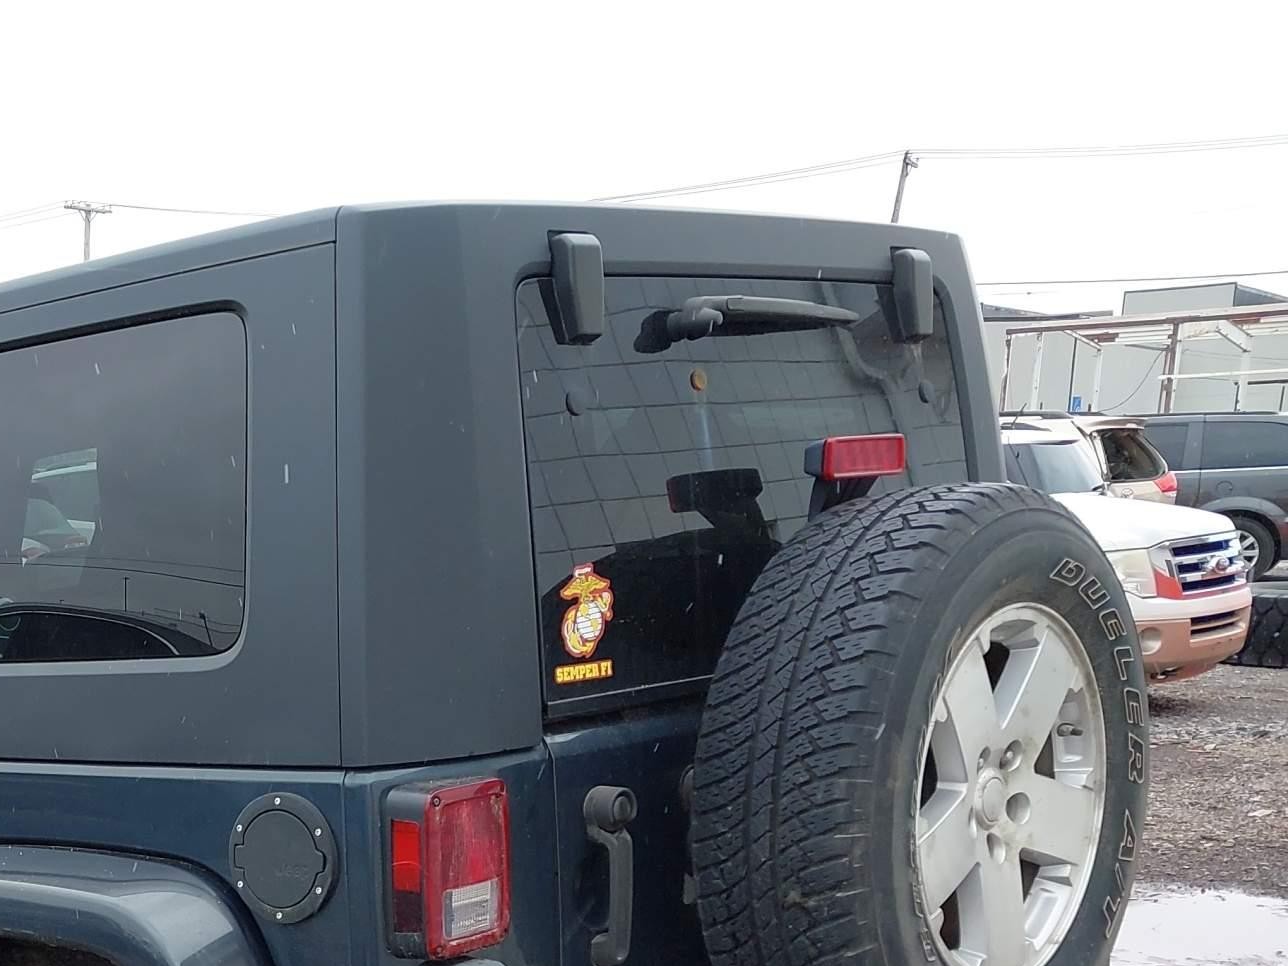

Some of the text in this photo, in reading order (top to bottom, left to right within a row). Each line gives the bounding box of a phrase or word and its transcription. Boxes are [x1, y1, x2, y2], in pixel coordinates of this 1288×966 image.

[556, 660, 613, 683] SEMPER FI
[1049, 558, 1145, 784] DUELER
